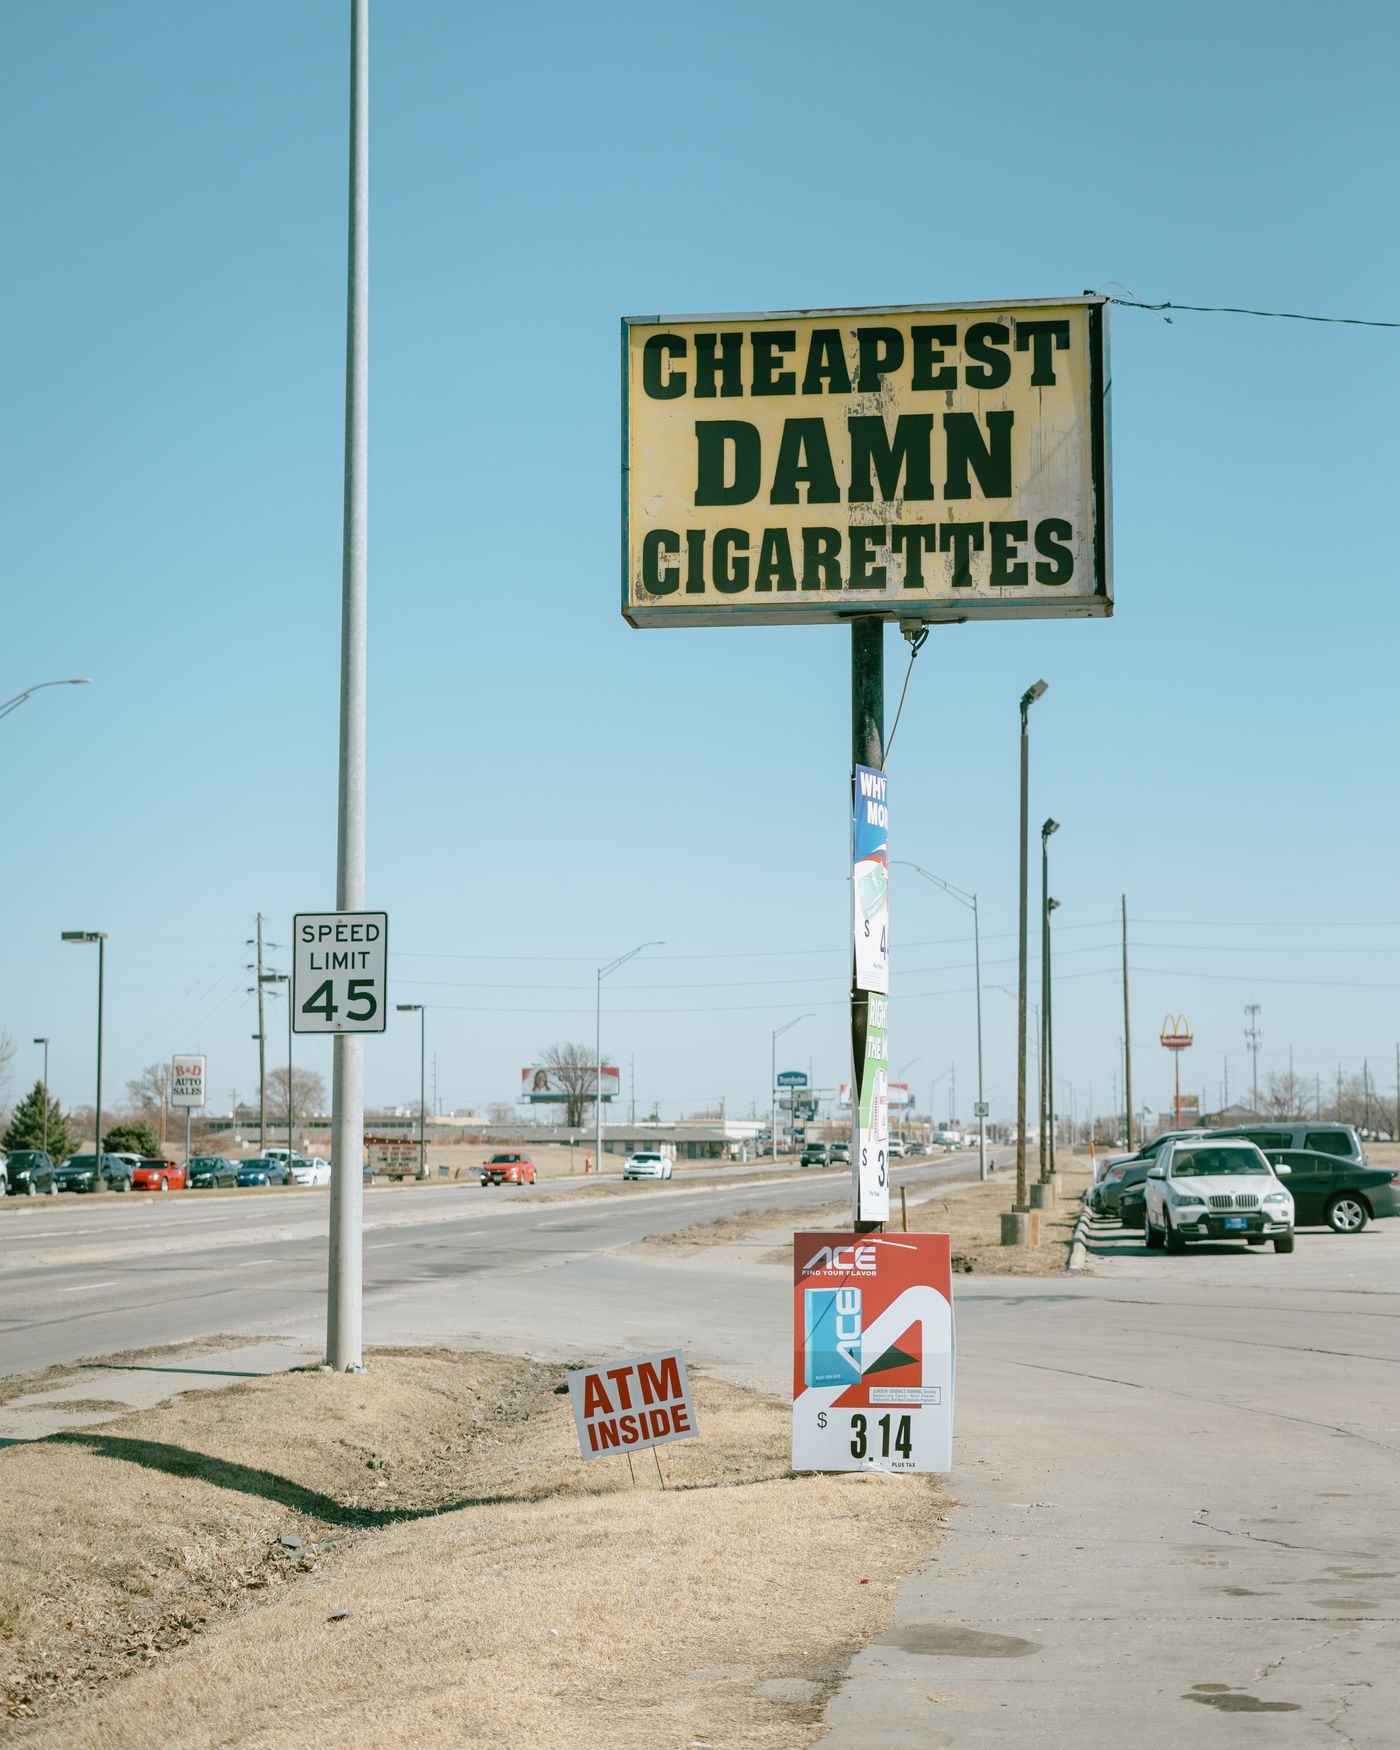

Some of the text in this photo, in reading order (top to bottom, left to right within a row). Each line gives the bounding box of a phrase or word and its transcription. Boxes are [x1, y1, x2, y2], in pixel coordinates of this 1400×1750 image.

[643, 320, 1070, 400] CHEAPEST
[694, 410, 1014, 506] DAMN
[643, 518, 1074, 596] CIGARETTES
[860, 772, 886, 801] WHY
[302, 924, 380, 943] SPEED
[310, 952, 370, 970] LIMIT
[302, 979, 377, 1021] 45
[867, 1035, 881, 1060] THE
[173, 1087, 202, 1095] SALES
[175, 1078, 202, 1086] AUTO
[803, 1246, 877, 1270] ACE
[836, 1287, 861, 1374] ACE
[584, 1357, 683, 1418] ATM
[587, 1403, 691, 1452] INSIDE
[817, 1411, 912, 1462] $ 3.14
